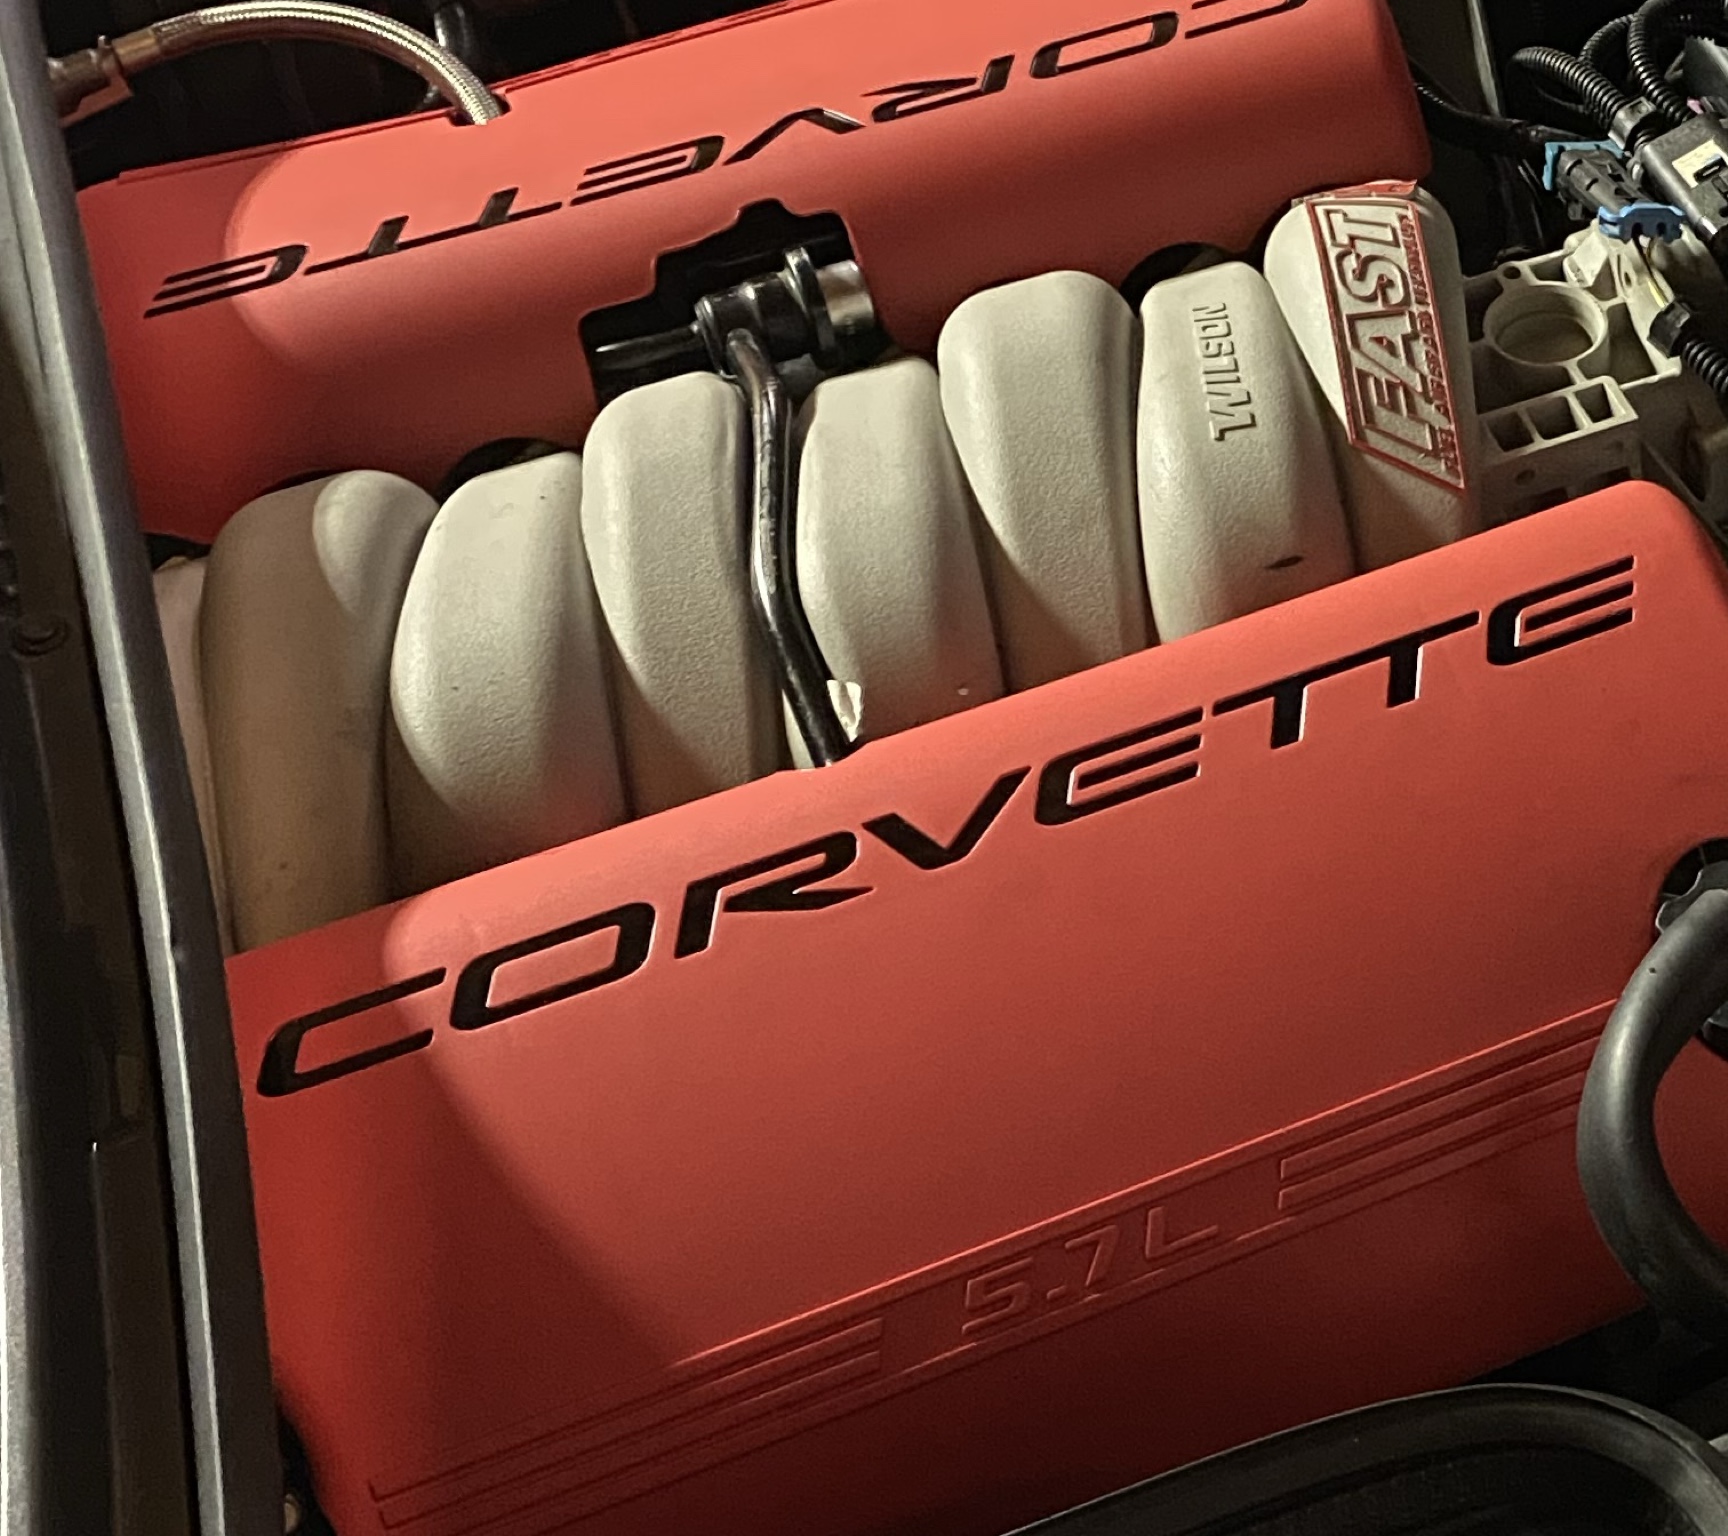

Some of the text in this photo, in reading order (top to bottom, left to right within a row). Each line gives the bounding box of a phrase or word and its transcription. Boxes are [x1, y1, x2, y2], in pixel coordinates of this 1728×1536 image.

[1191, 301, 1257, 443] WILSON
[1322, 206, 1432, 451] FAST
[256, 555, 1634, 1098] CORVETTE
[961, 1205, 1220, 1335] 5.7L
